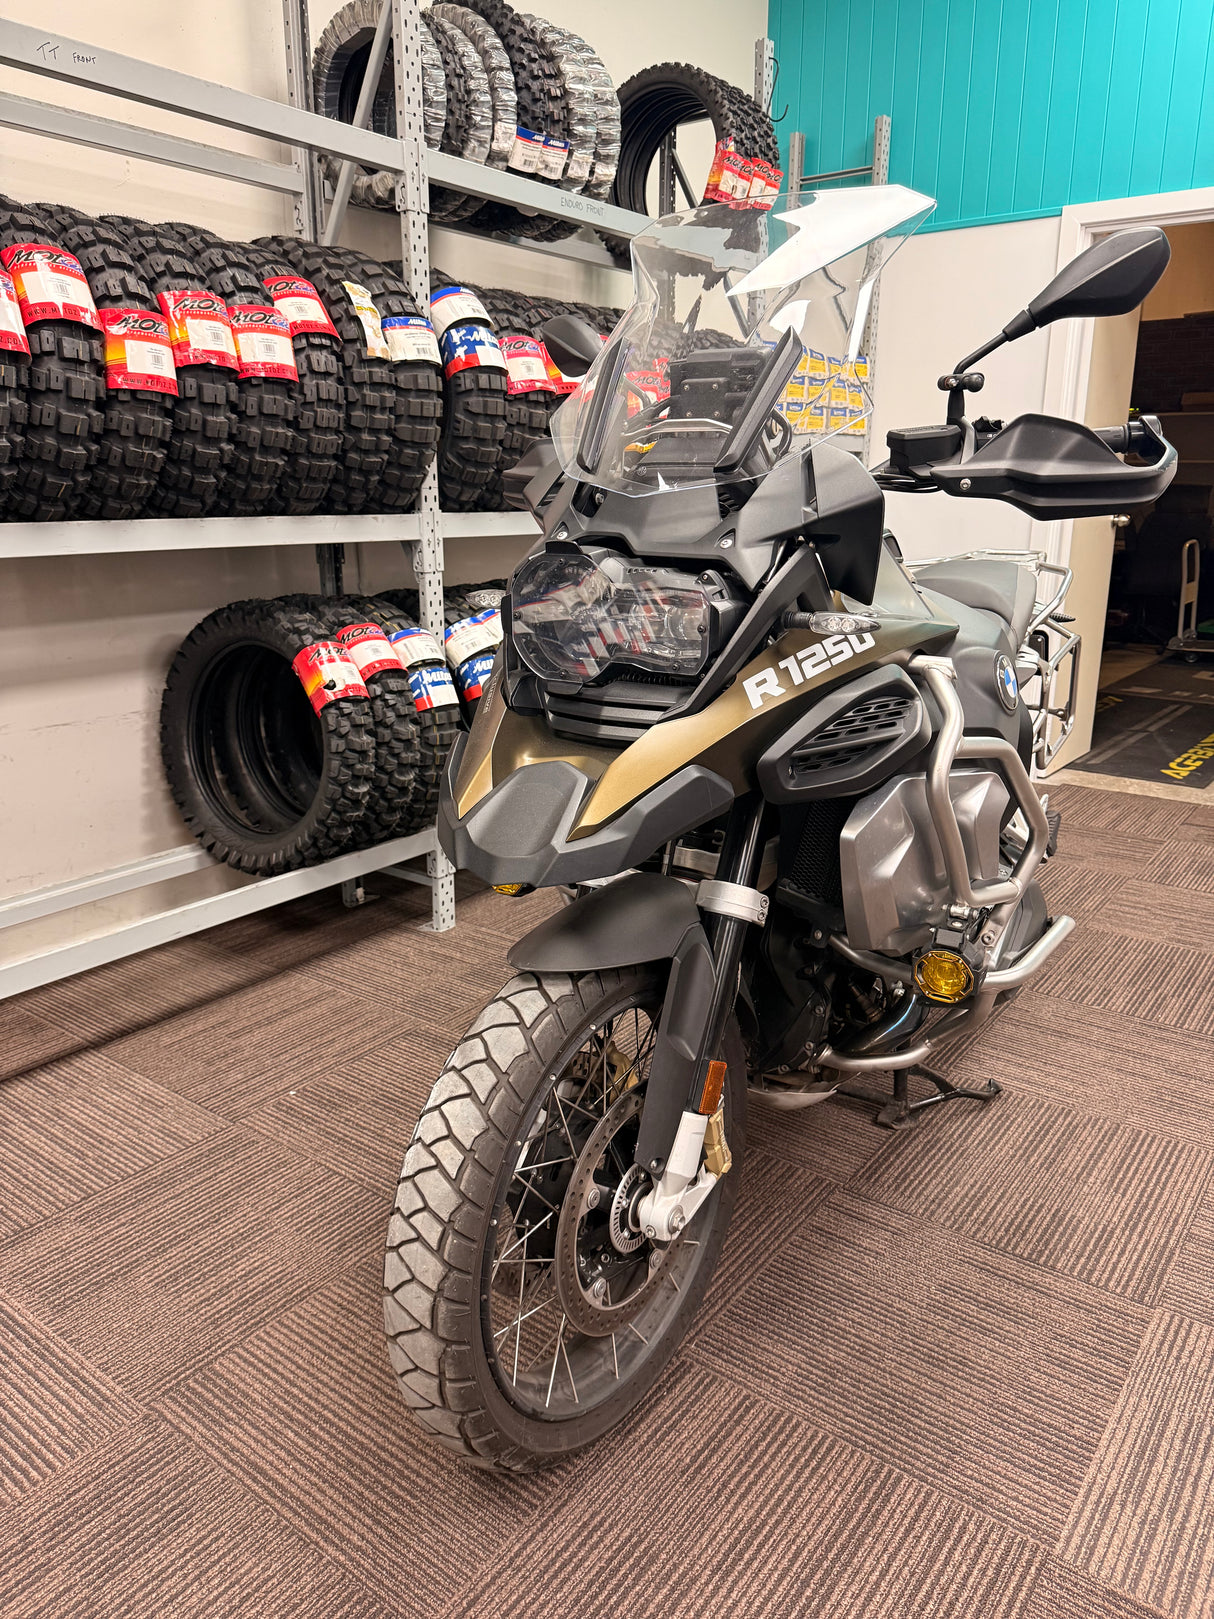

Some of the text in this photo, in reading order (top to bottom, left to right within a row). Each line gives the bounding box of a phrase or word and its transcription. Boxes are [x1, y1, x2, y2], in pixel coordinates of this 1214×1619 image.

[36, 41, 96, 64] TT FRONT
[560, 197, 584, 211] ENDURO
[742, 631, 876, 710] R 1250
